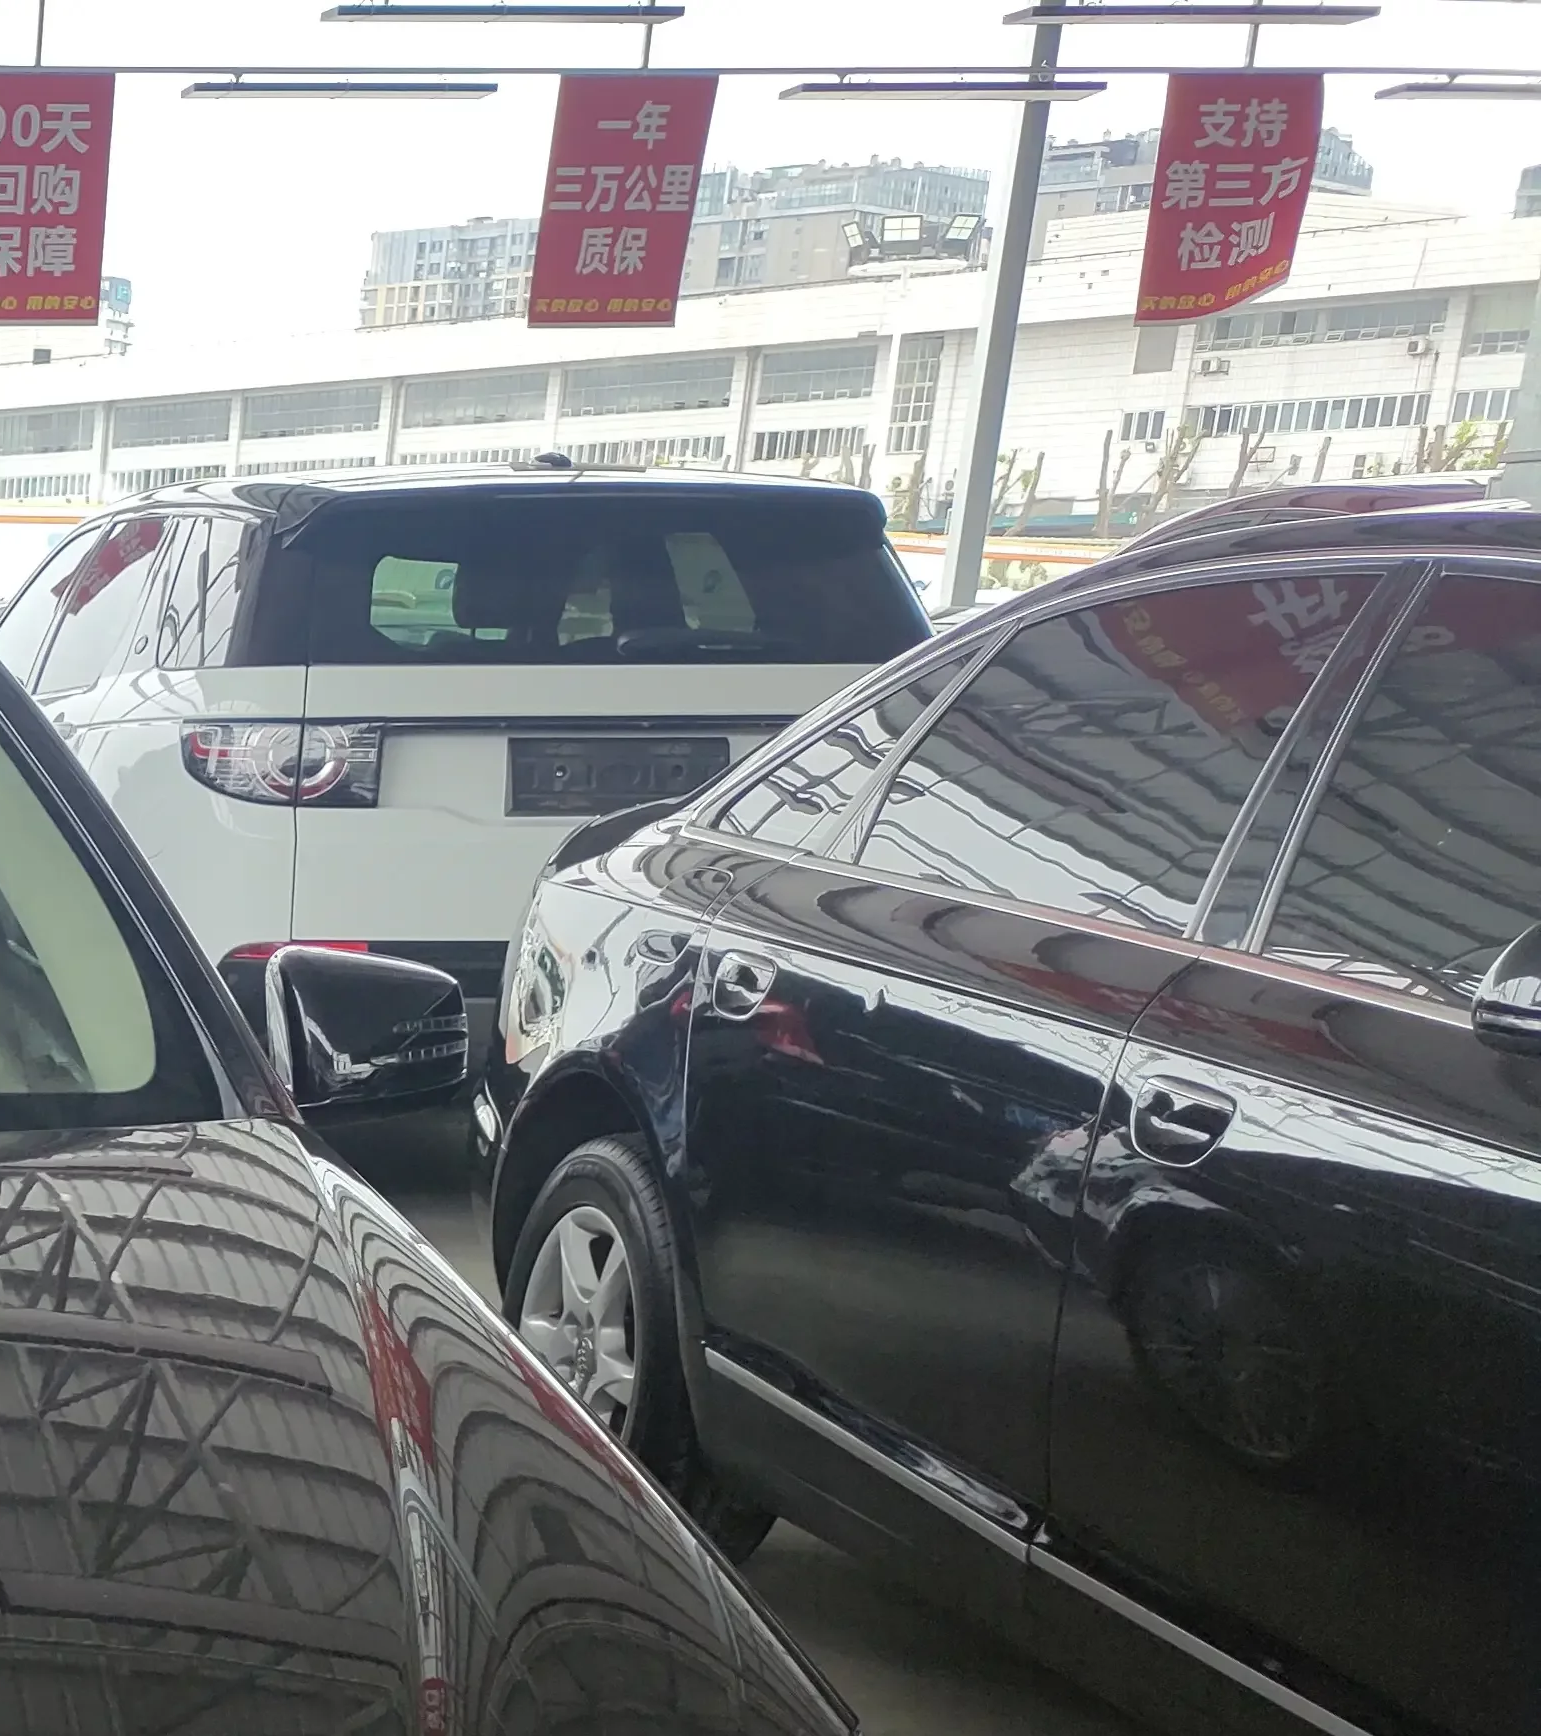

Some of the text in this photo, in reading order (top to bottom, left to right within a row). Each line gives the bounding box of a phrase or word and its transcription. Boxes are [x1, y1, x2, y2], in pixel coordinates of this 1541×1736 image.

[596, 100, 672, 150] 一年
[1194, 98, 1289, 148] 支持
[548, 164, 695, 212] 三万公里
[1162, 156, 1310, 210] 第三方
[575, 226, 648, 275] 质保
[1177, 212, 1276, 271] 检测
